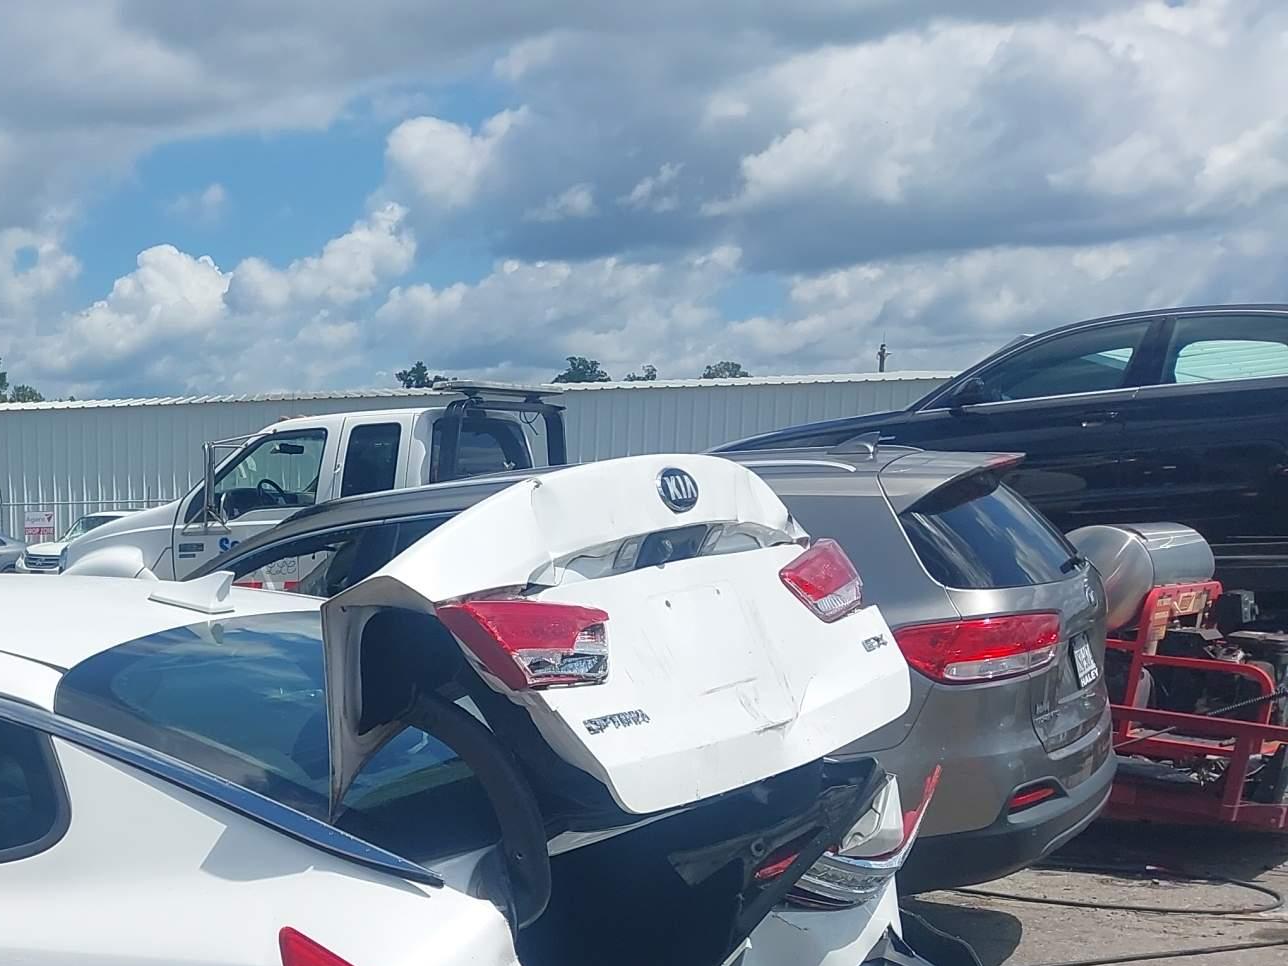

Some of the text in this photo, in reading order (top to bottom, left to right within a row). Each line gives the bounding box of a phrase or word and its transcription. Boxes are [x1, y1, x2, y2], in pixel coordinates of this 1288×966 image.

[663, 475, 697, 500] KIA
[25, 527, 40, 536] DROP
[862, 633, 888, 652] EX
[1080, 668, 1099, 687] HALEY
[582, 709, 651, 735] OPTIMA
